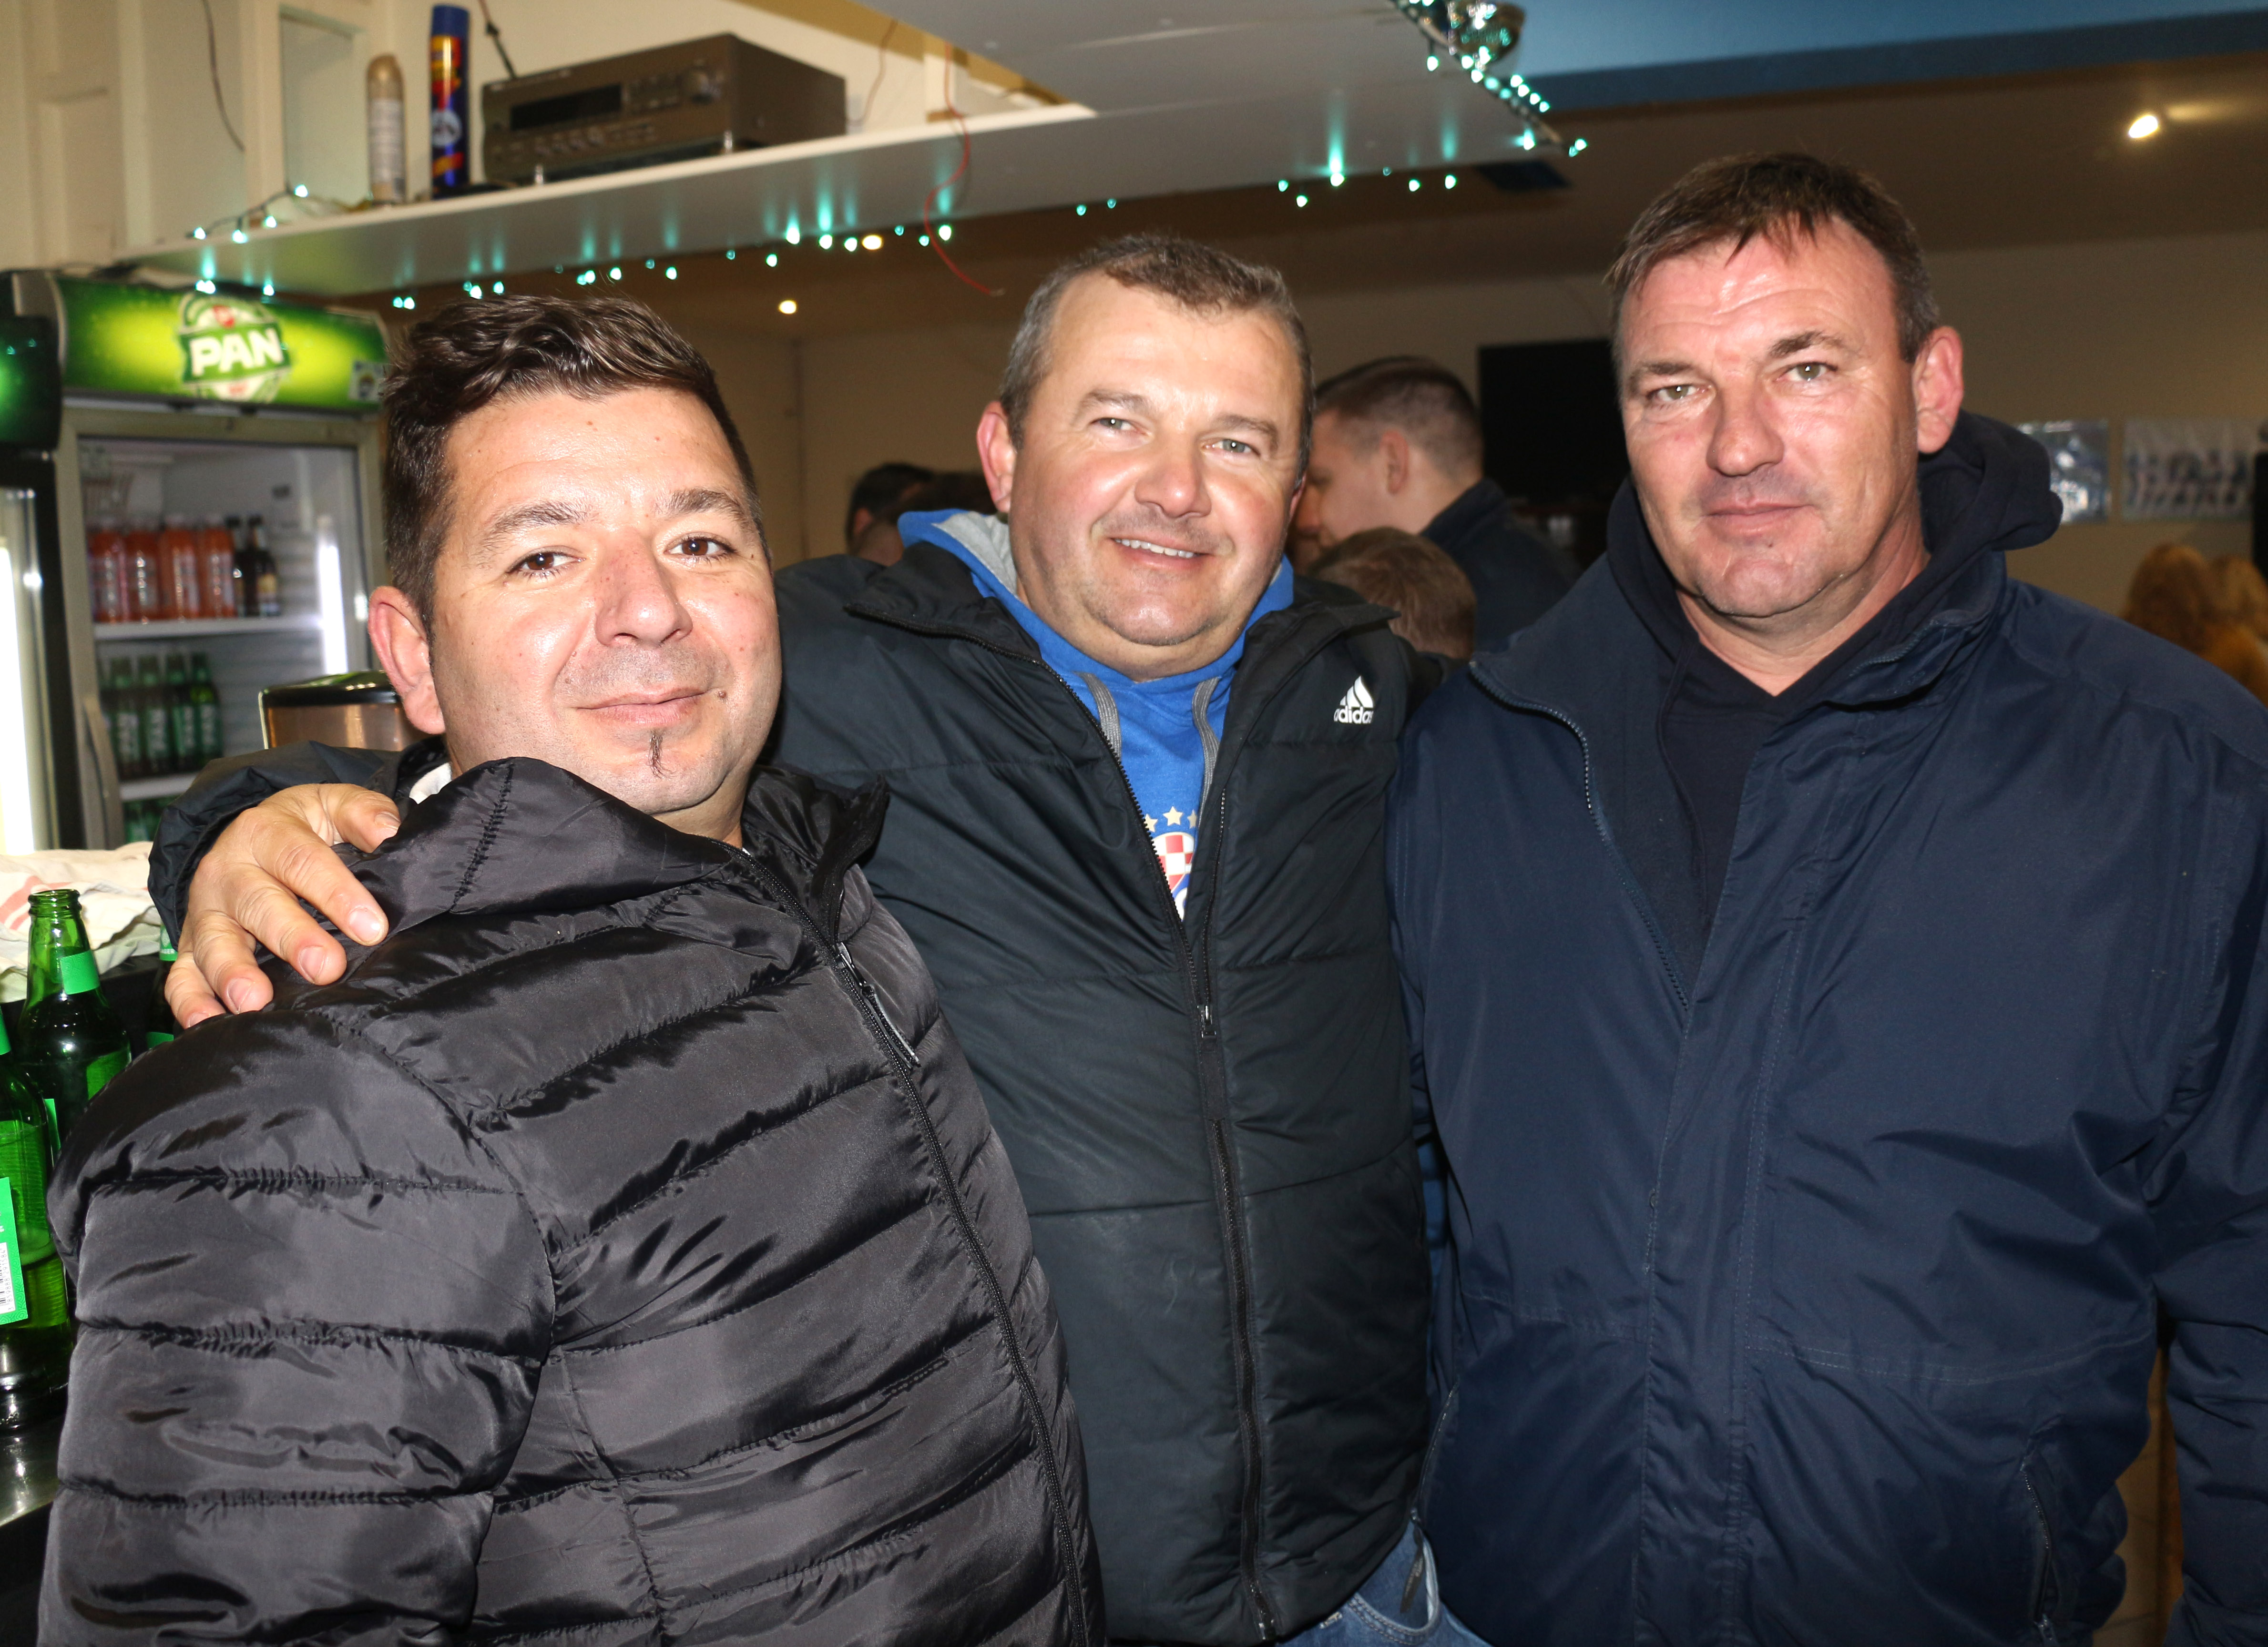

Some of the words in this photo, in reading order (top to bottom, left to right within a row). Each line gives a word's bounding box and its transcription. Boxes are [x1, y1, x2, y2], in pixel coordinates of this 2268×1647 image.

[190, 328, 283, 376] PAN
[1334, 705, 1374, 723] adidas
[0, 1250, 9, 1274] 291584
[4, 1278, 12, 1302] 859888
